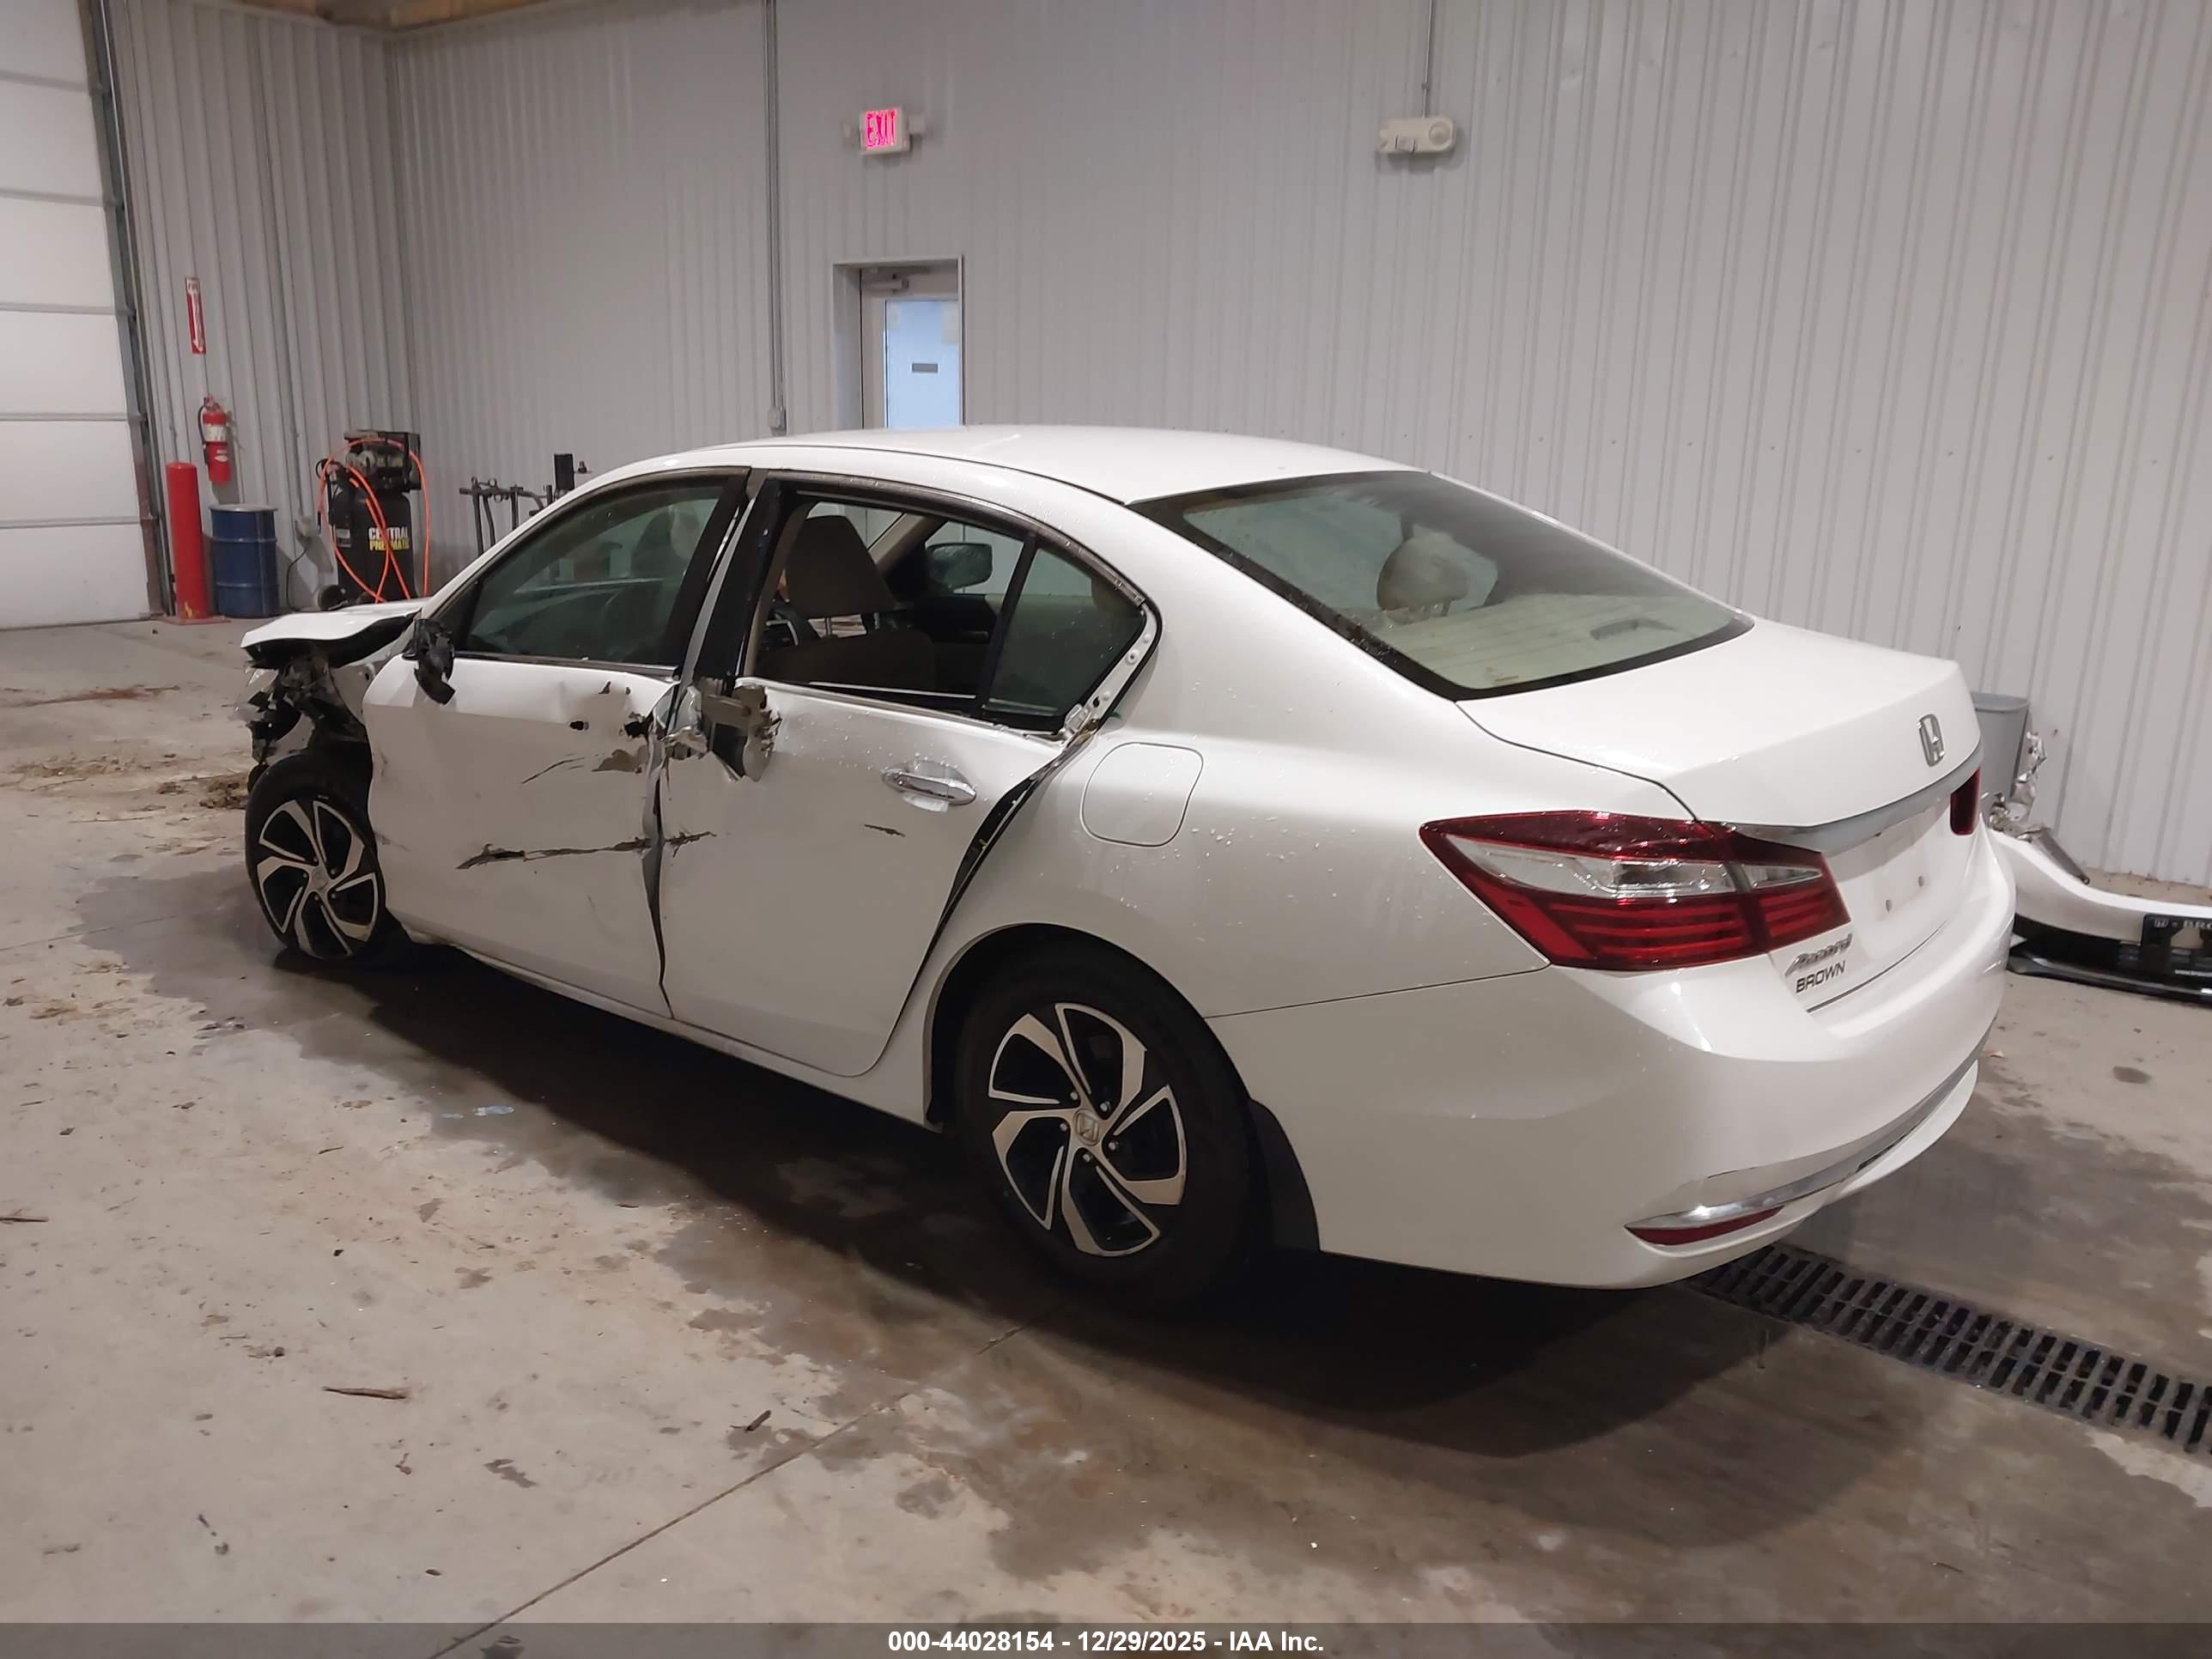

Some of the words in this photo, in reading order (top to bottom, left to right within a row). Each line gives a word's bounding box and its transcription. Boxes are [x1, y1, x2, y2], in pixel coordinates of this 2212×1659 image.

[866, 109, 896, 148] EXIT
[368, 526, 409, 541] CETRAL
[369, 538, 410, 551] PNEMATIC
[1796, 960, 1845, 993] BROWN
